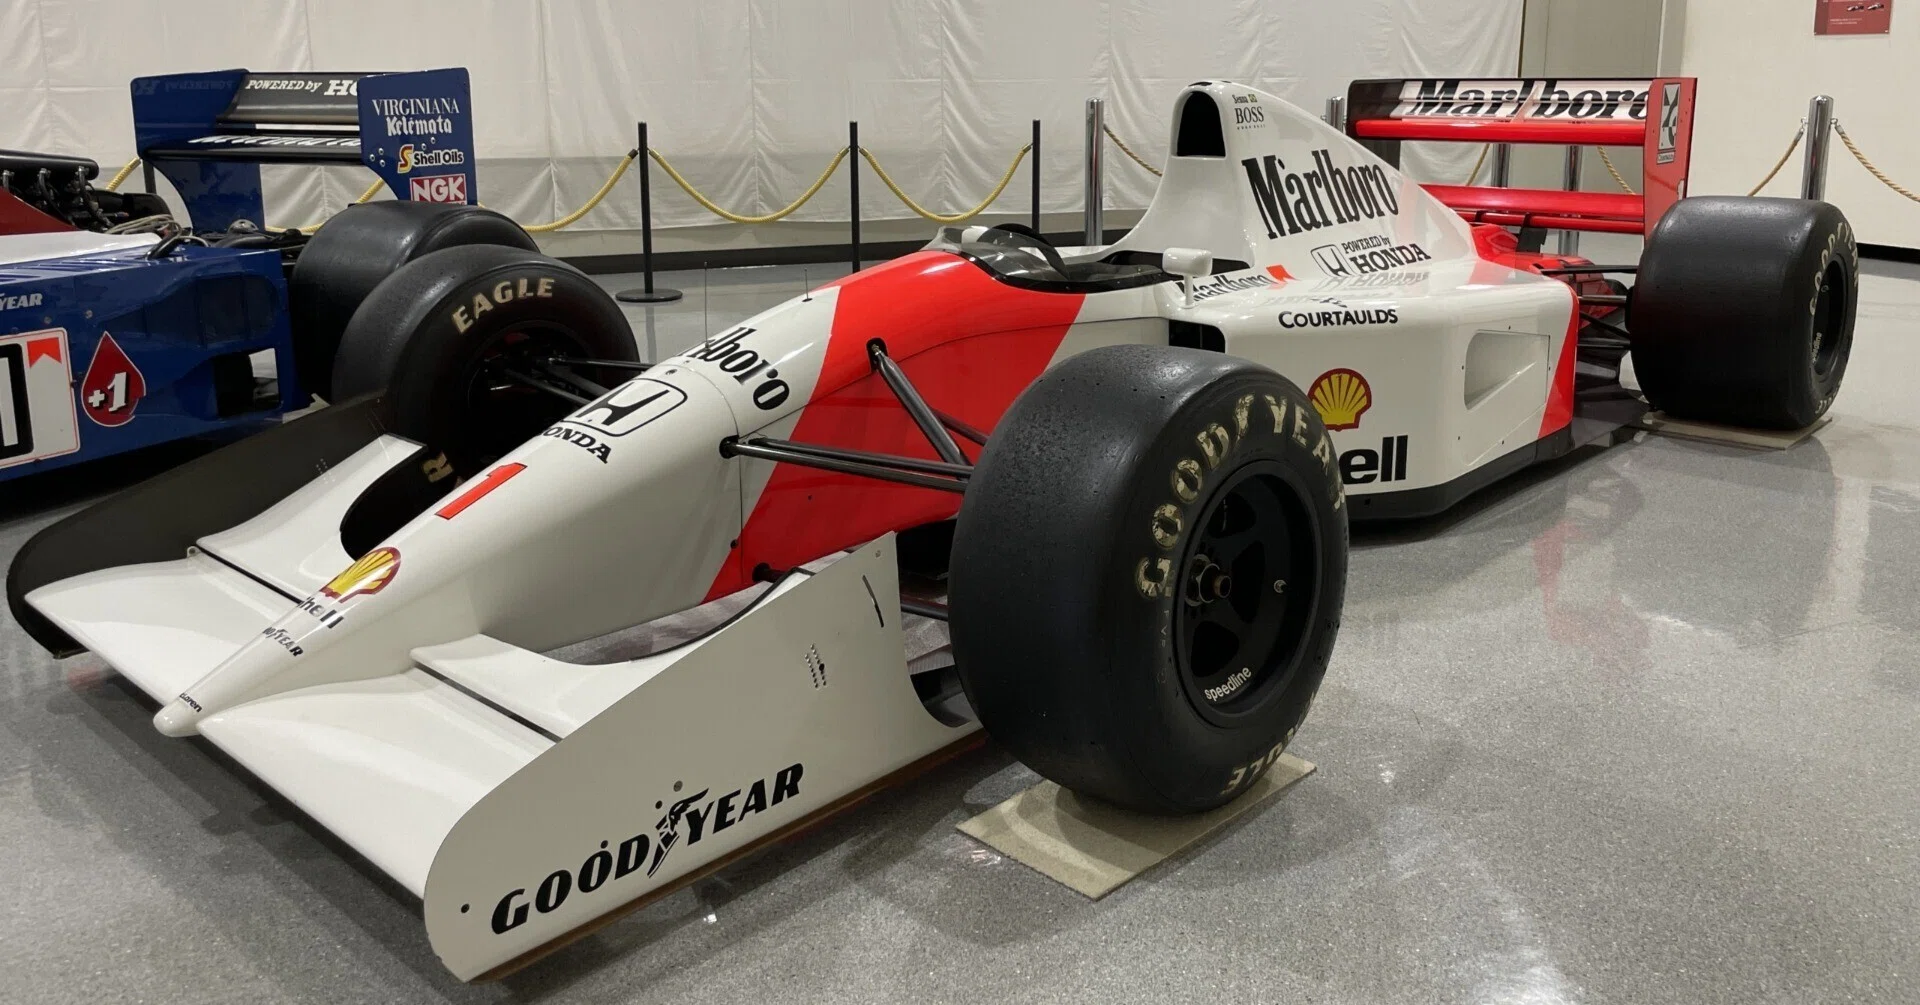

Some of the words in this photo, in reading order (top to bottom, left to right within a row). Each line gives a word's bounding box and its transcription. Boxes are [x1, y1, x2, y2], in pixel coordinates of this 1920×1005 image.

[245, 80, 305, 90] POWERED
[305, 80, 322, 92] by
[372, 98, 460, 116] VIRGINIANA
[1234, 106, 1265, 124] BOSS
[414, 151, 441, 166] Shell
[442, 150, 464, 164] Oils
[412, 176, 466, 203] NGK
[1241, 149, 1399, 240] Marlboro
[1341, 237, 1382, 254] POWERED
[1380, 235, 1392, 248] by
[1350, 243, 1431, 274] HONDA
[1175, 274, 1279, 302] Marlboro
[452, 278, 555, 334] EAGLE
[1278, 308, 1399, 329] COURTAULDS
[88, 372, 128, 412] +1
[541, 426, 612, 464] ONDA
[1339, 434, 1408, 485] ell
[435, 462, 527, 520] 1
[300, 597, 344, 629] hell
[1204, 667, 1252, 702] speedline
[491, 763, 804, 935] GOODYEAR
